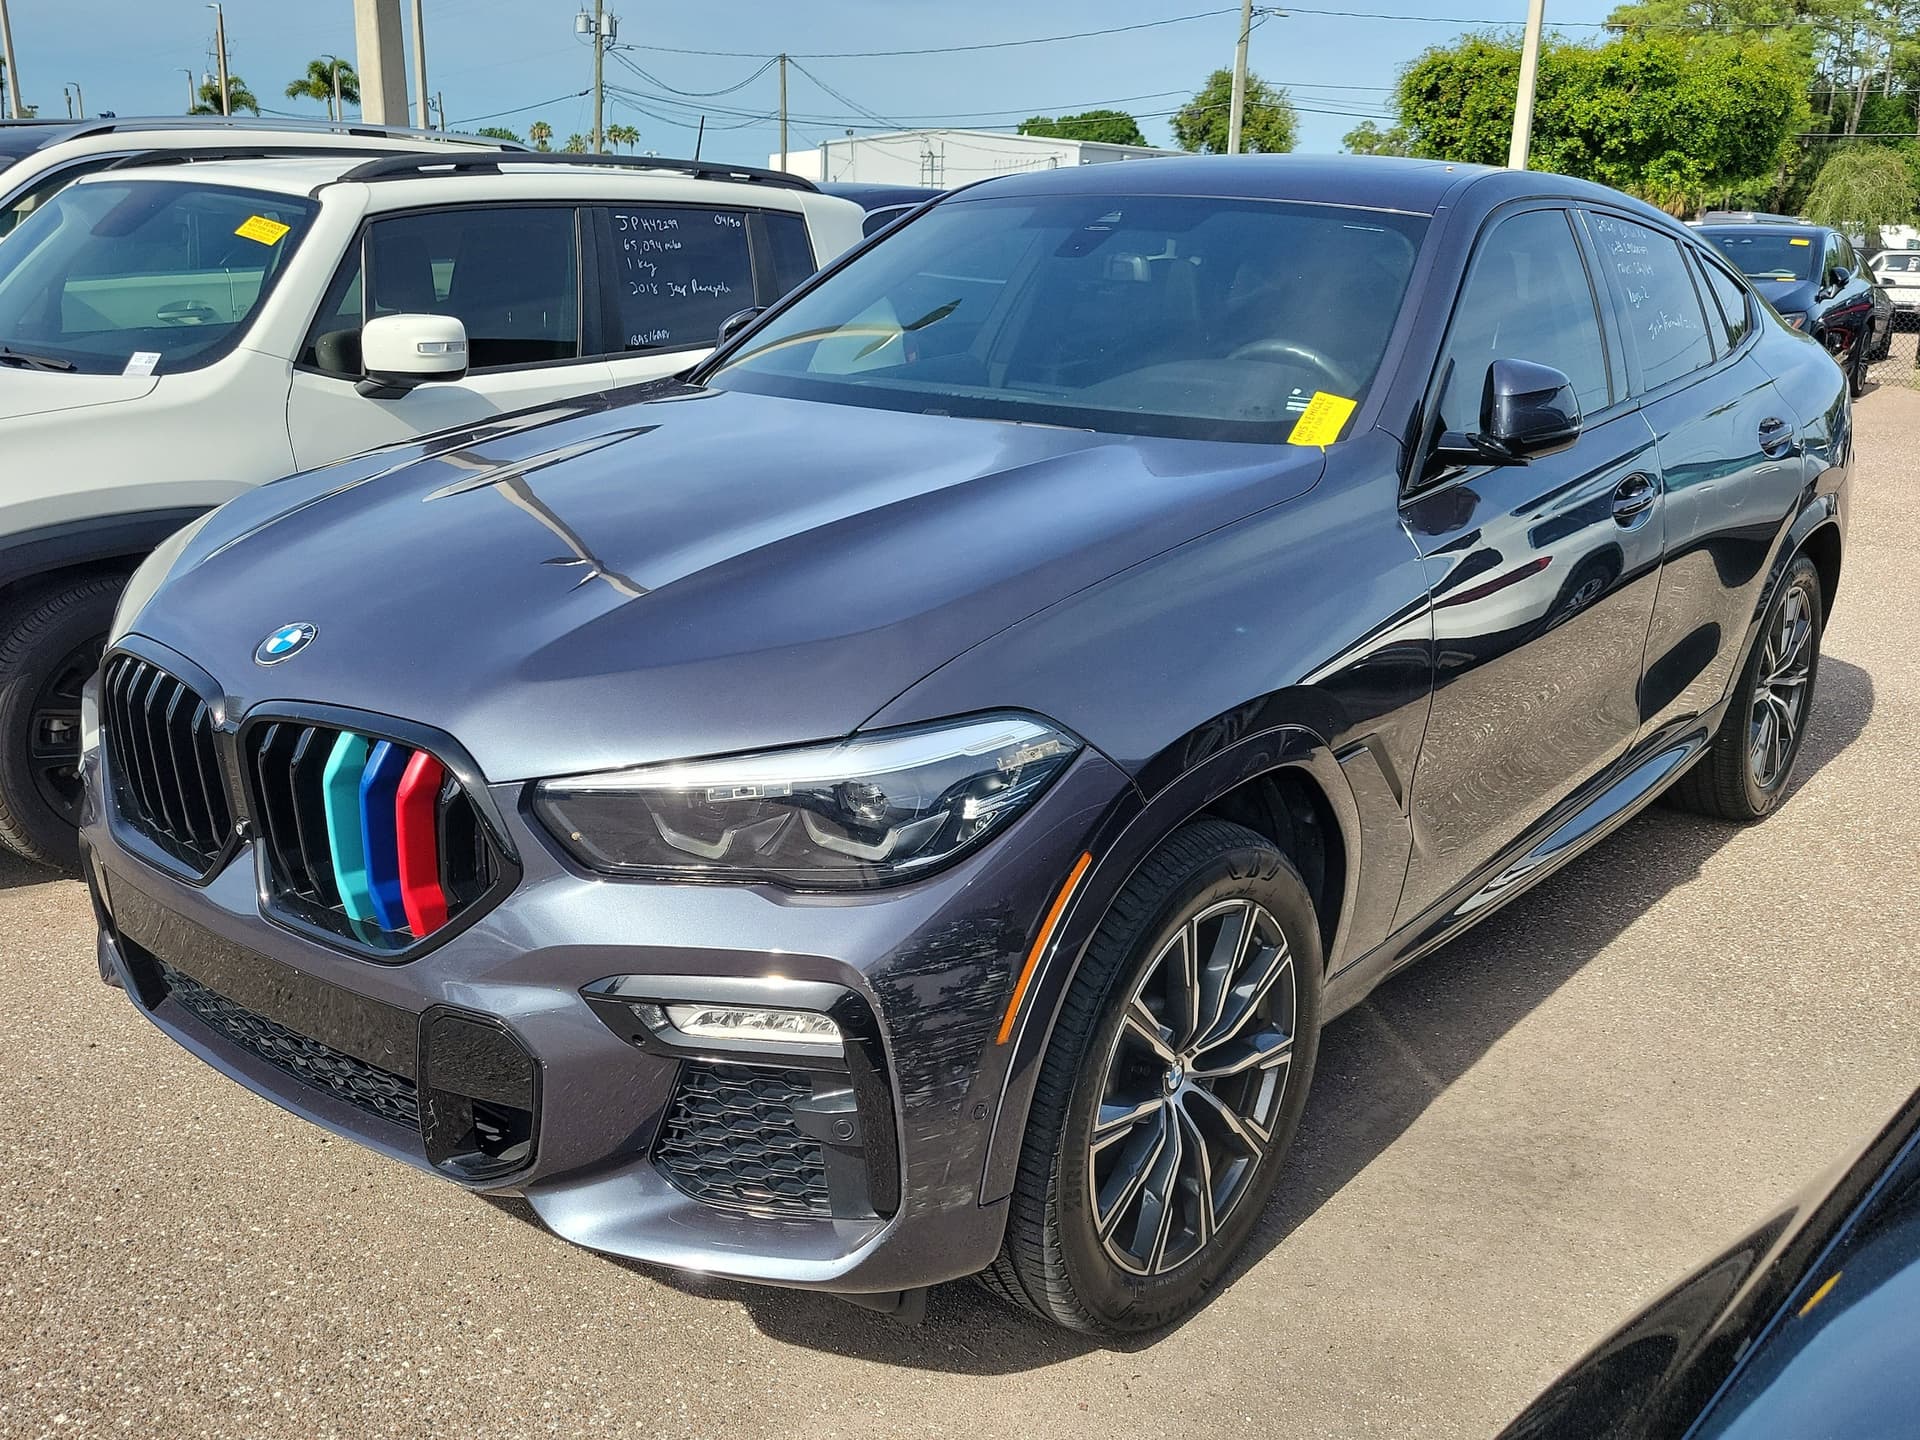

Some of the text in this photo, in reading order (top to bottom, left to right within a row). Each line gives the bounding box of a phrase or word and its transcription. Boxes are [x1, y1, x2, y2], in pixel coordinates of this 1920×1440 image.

[629, 281, 658, 295] 2018
[1293, 396, 1326, 442] THIS VEHICLE
